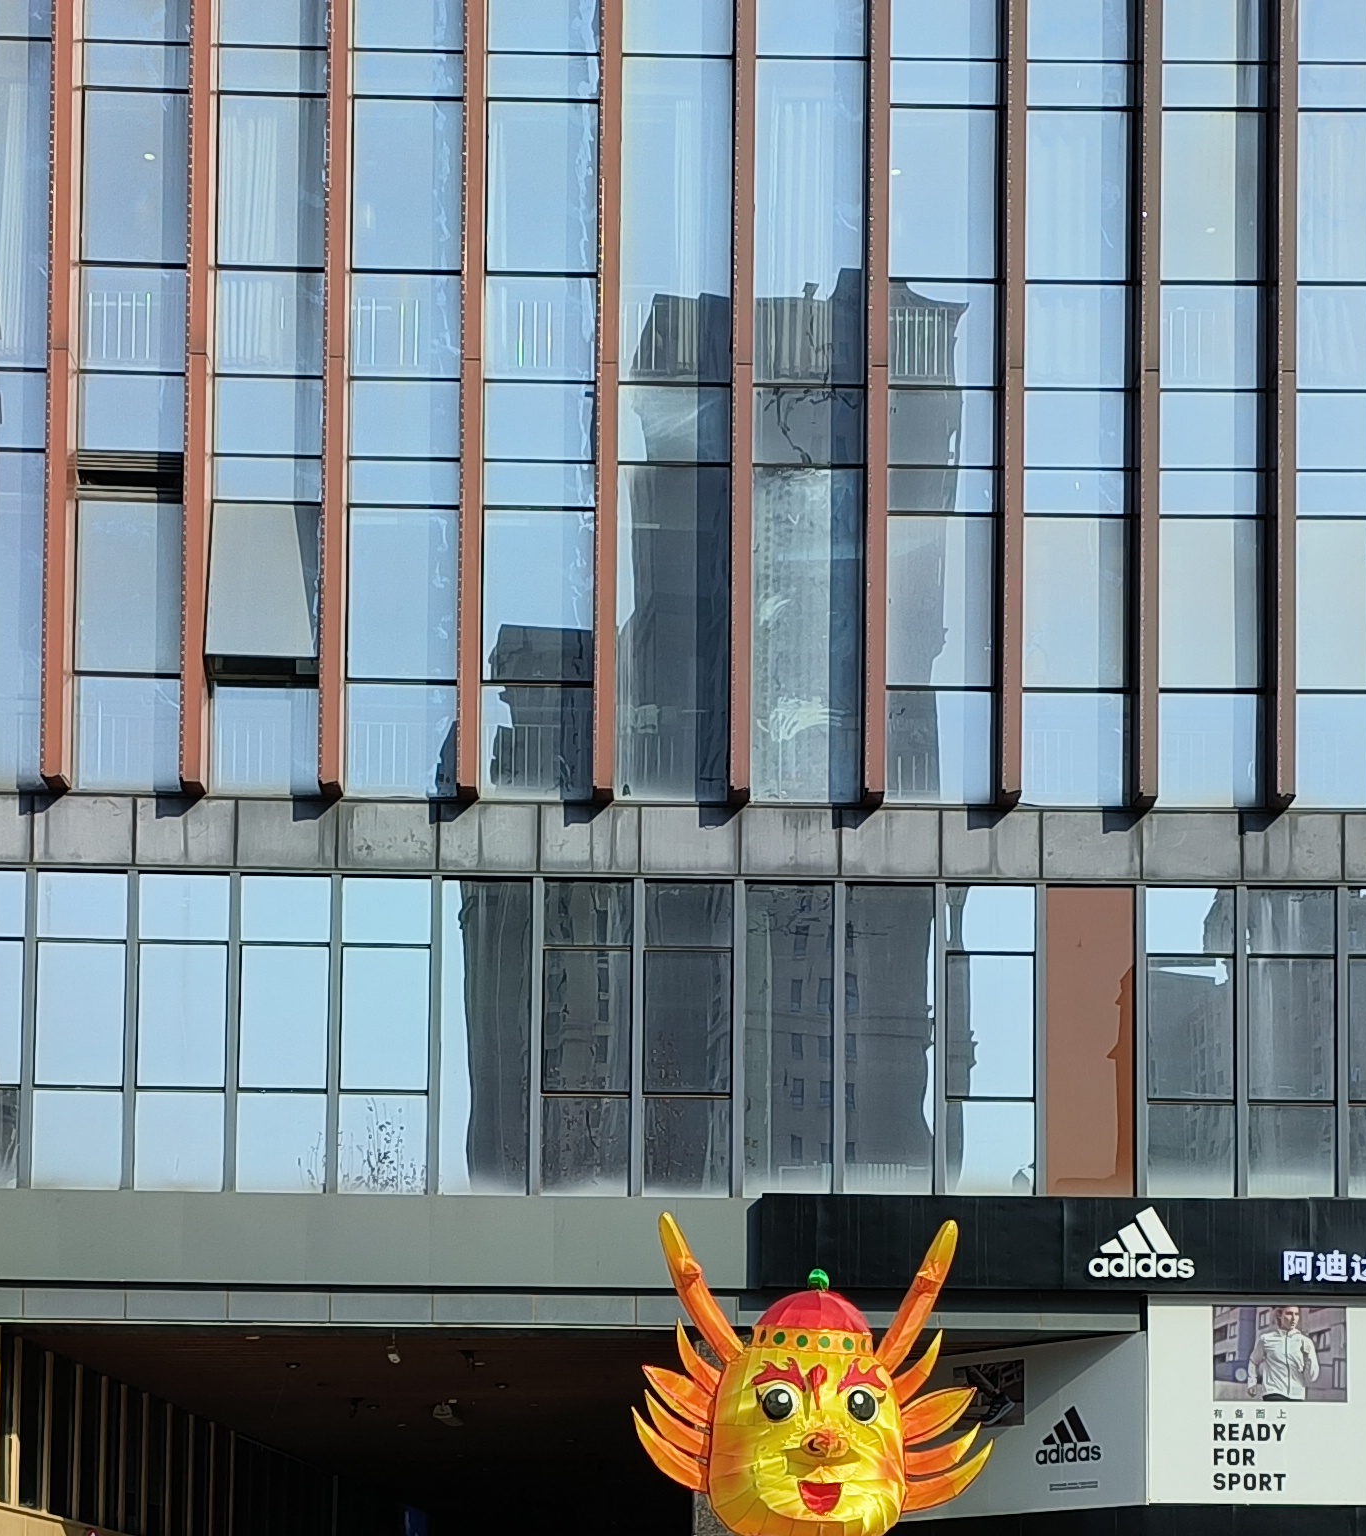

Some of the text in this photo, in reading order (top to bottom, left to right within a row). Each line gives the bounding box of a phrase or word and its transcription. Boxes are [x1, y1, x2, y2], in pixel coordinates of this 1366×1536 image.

[1088, 1252, 1195, 1279] adidas
[1213, 1423, 1286, 1441] READY
[1035, 1442, 1102, 1465] adidas
[1213, 1448, 1255, 1466] FOR
[1213, 1472, 1286, 1491] SPORT
